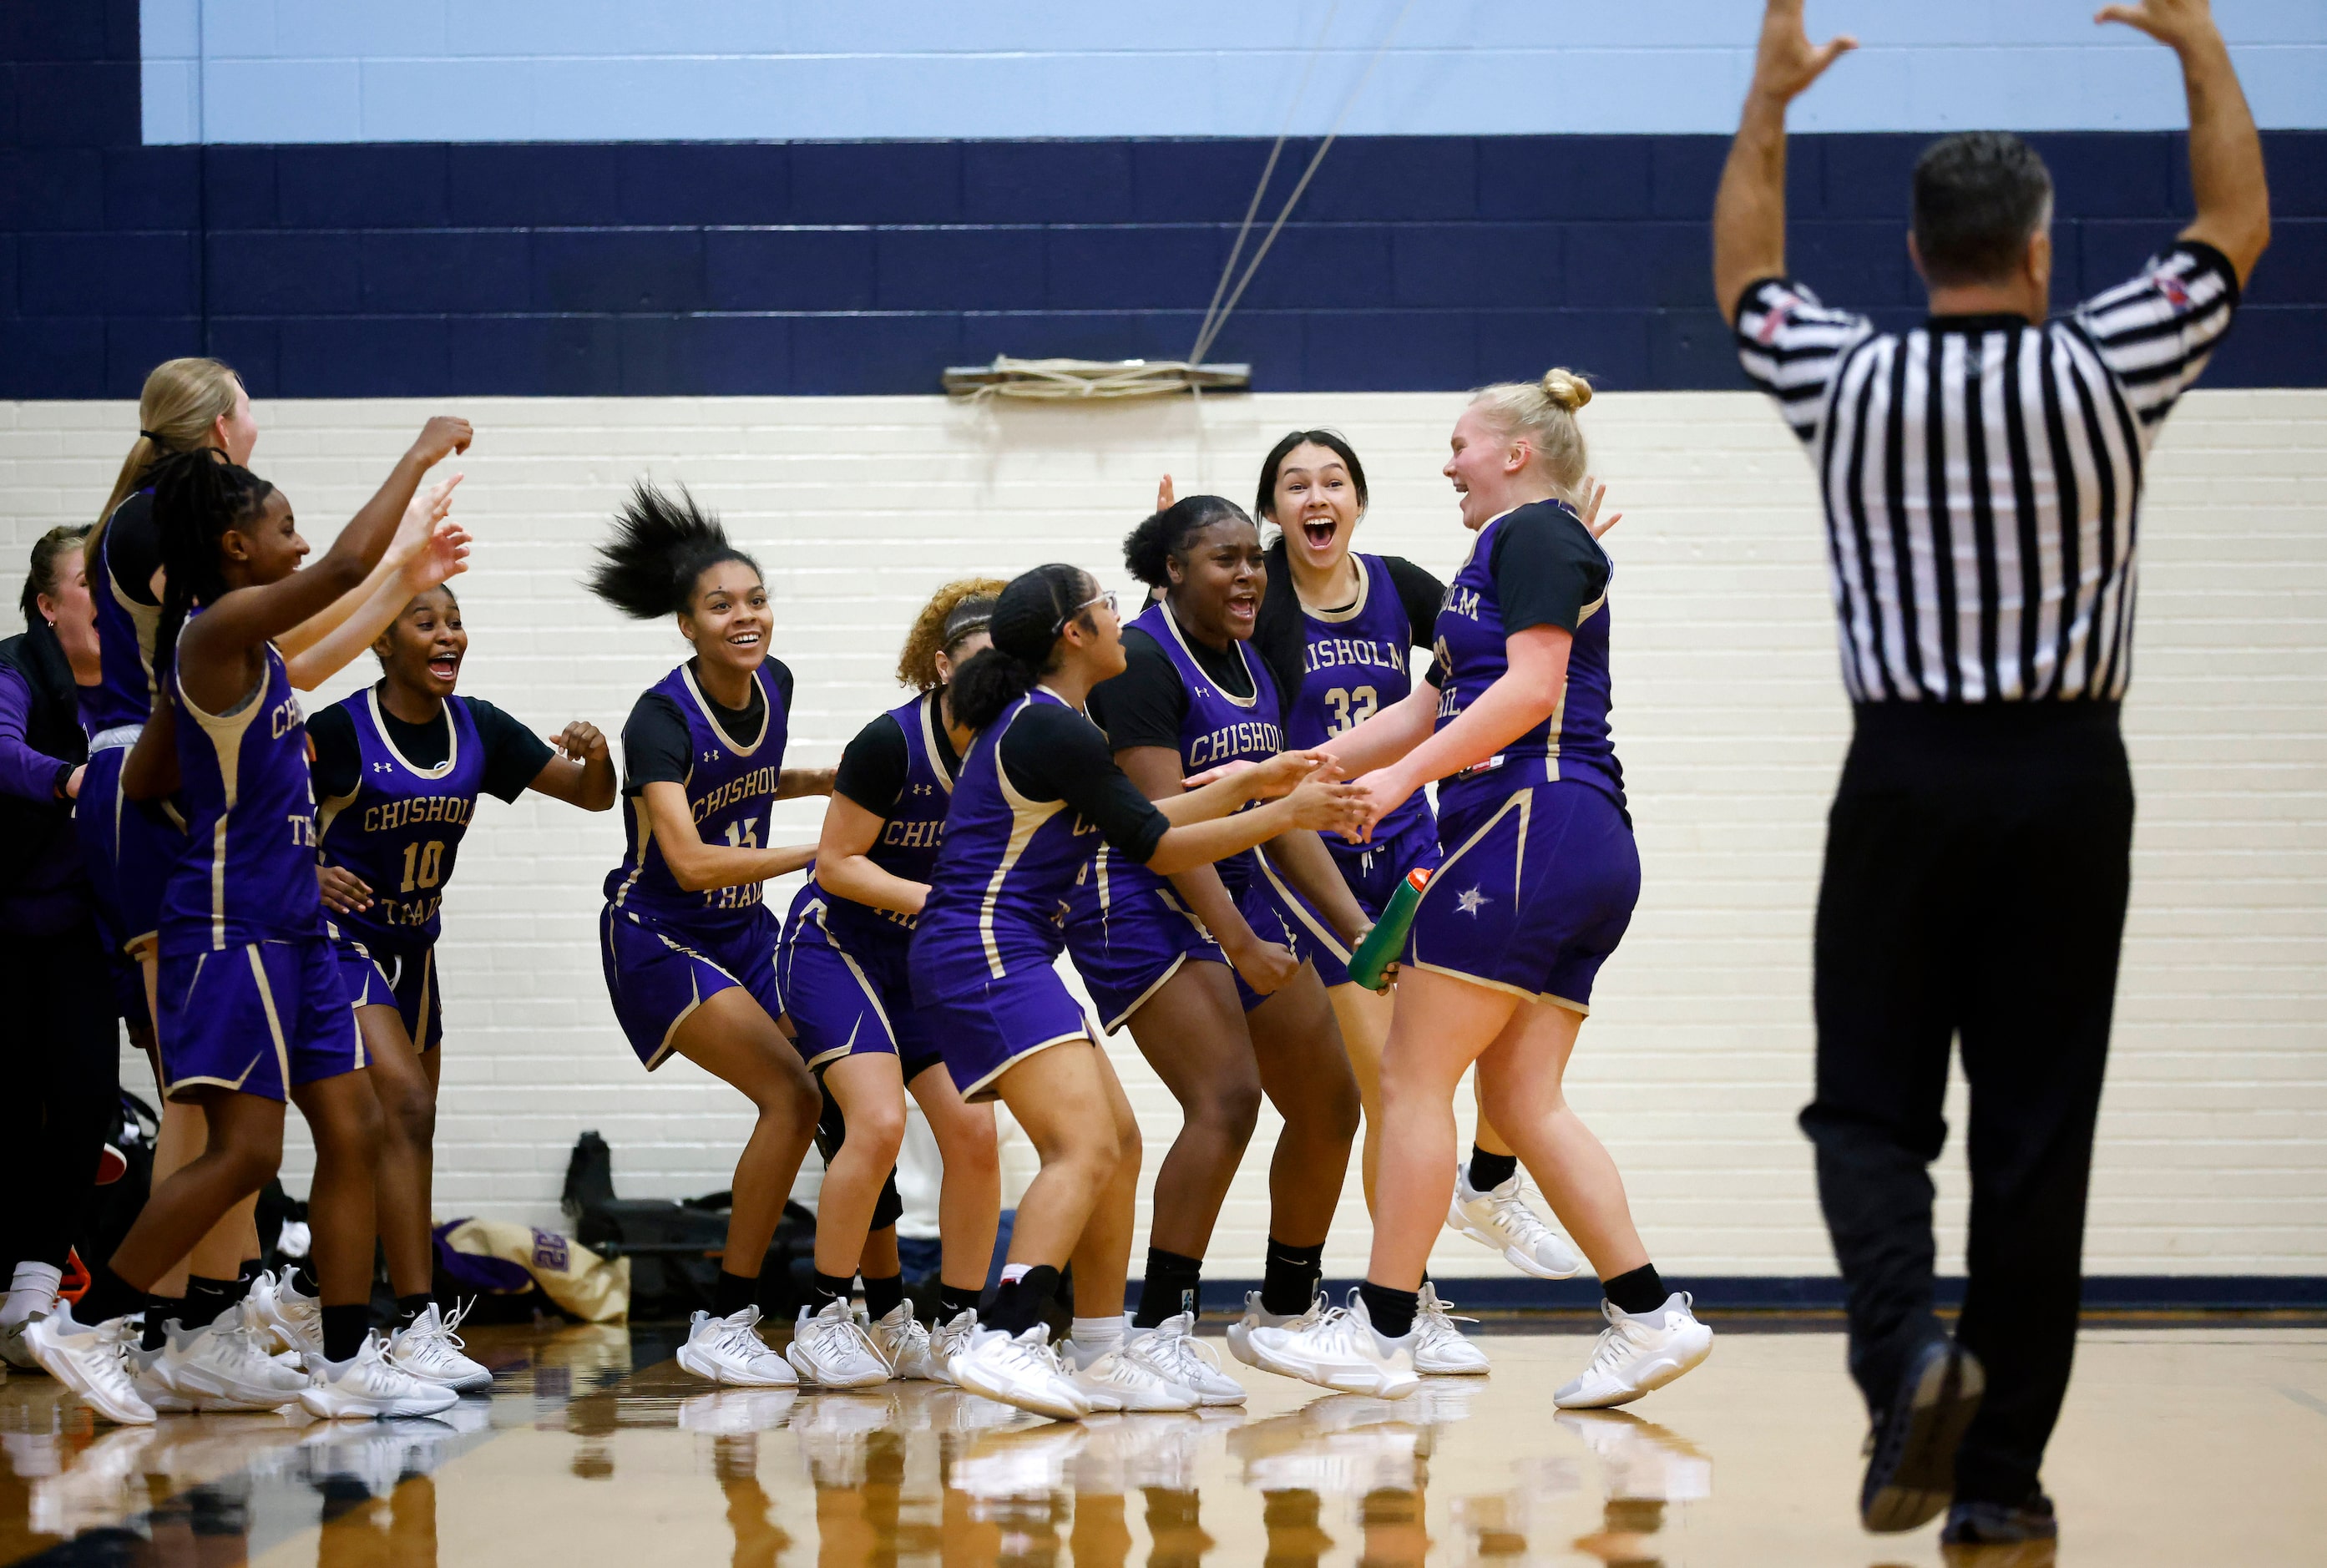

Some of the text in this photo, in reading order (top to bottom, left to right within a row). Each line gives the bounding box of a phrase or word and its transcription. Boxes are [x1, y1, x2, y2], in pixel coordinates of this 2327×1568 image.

[1324, 685, 1378, 739] 32
[691, 766, 782, 825] CHISHOL
[400, 840, 445, 893] 10
